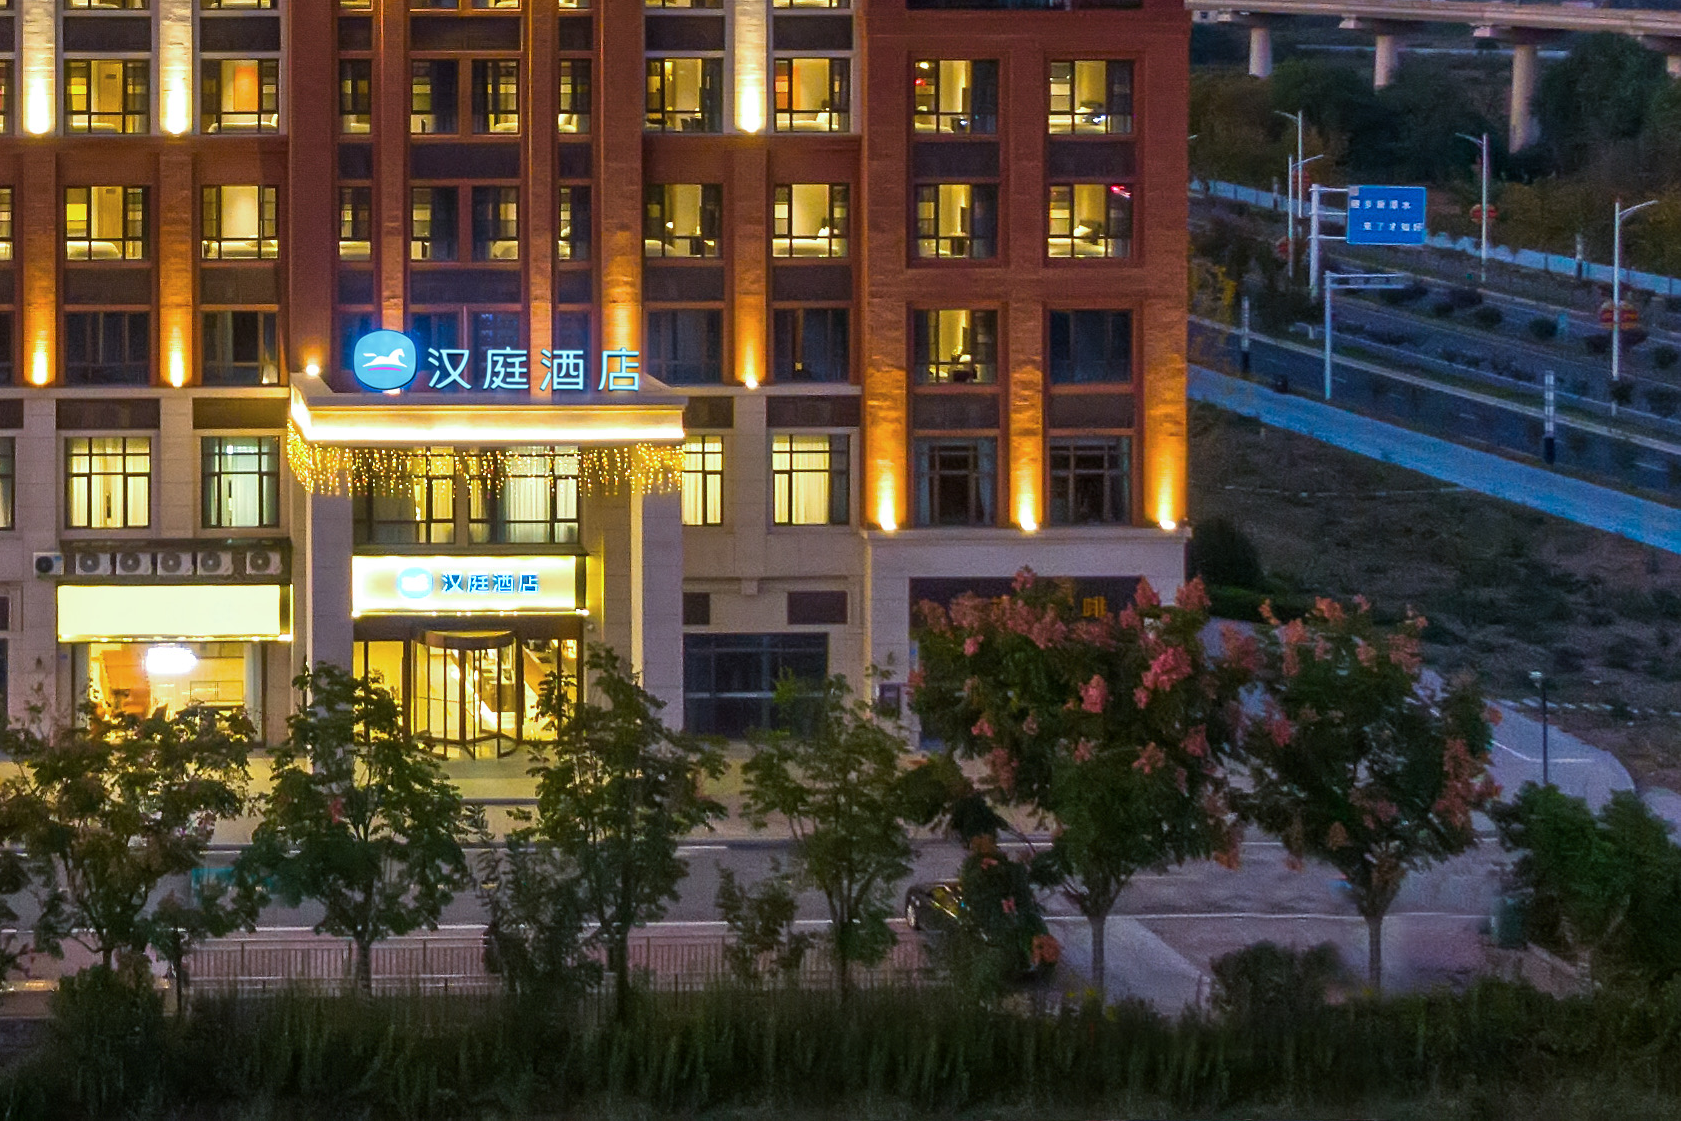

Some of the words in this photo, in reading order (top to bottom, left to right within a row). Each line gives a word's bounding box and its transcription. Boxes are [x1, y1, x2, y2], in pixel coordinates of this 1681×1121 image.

[427, 346, 641, 392] 汉庭酒店
[441, 572, 539, 594] 汉庭酒店
